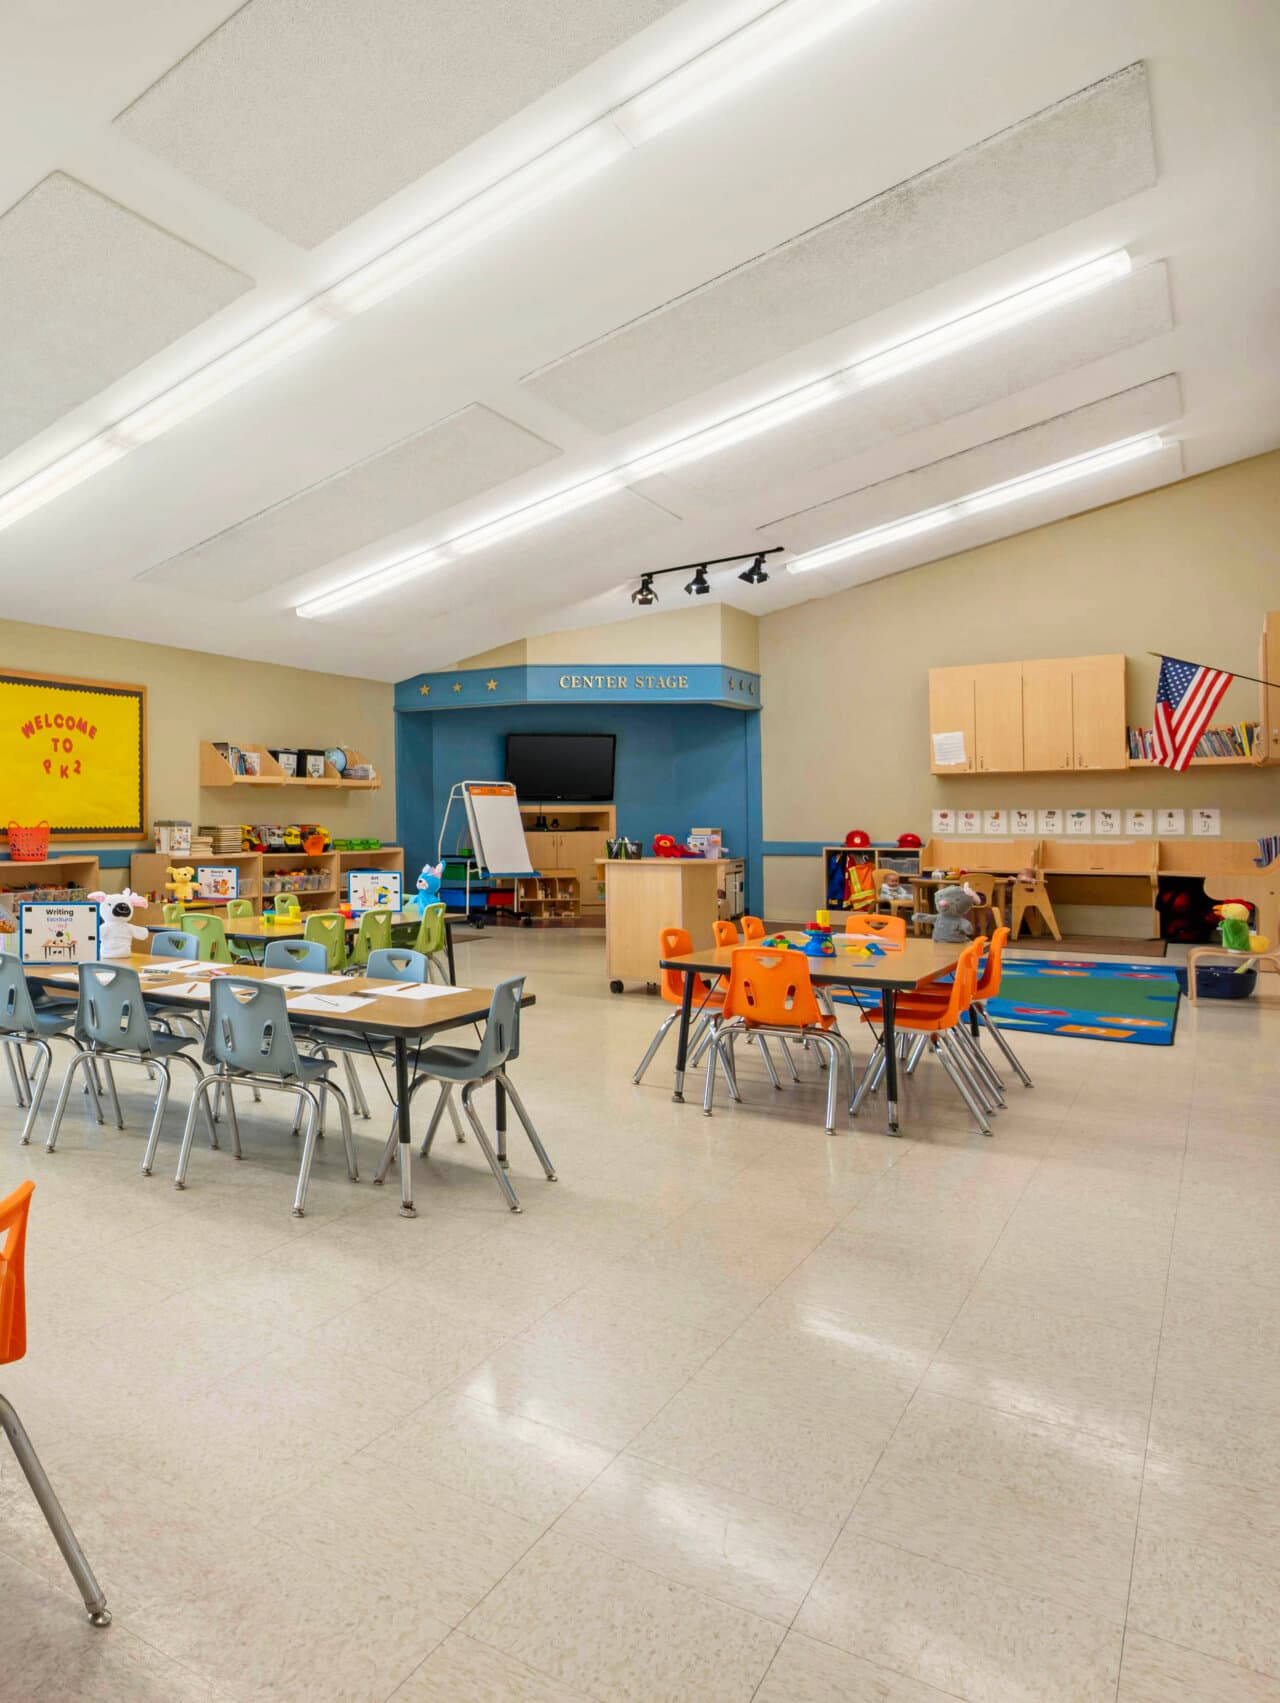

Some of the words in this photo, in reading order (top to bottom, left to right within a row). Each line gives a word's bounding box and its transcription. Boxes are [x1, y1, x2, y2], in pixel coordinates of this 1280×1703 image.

[559, 675, 628, 689] CENTER
[634, 675, 688, 689] STAGE
[21, 713, 97, 740] WELCOME
[51, 737, 73, 753] TO
[46, 908, 74, 917] Writing
